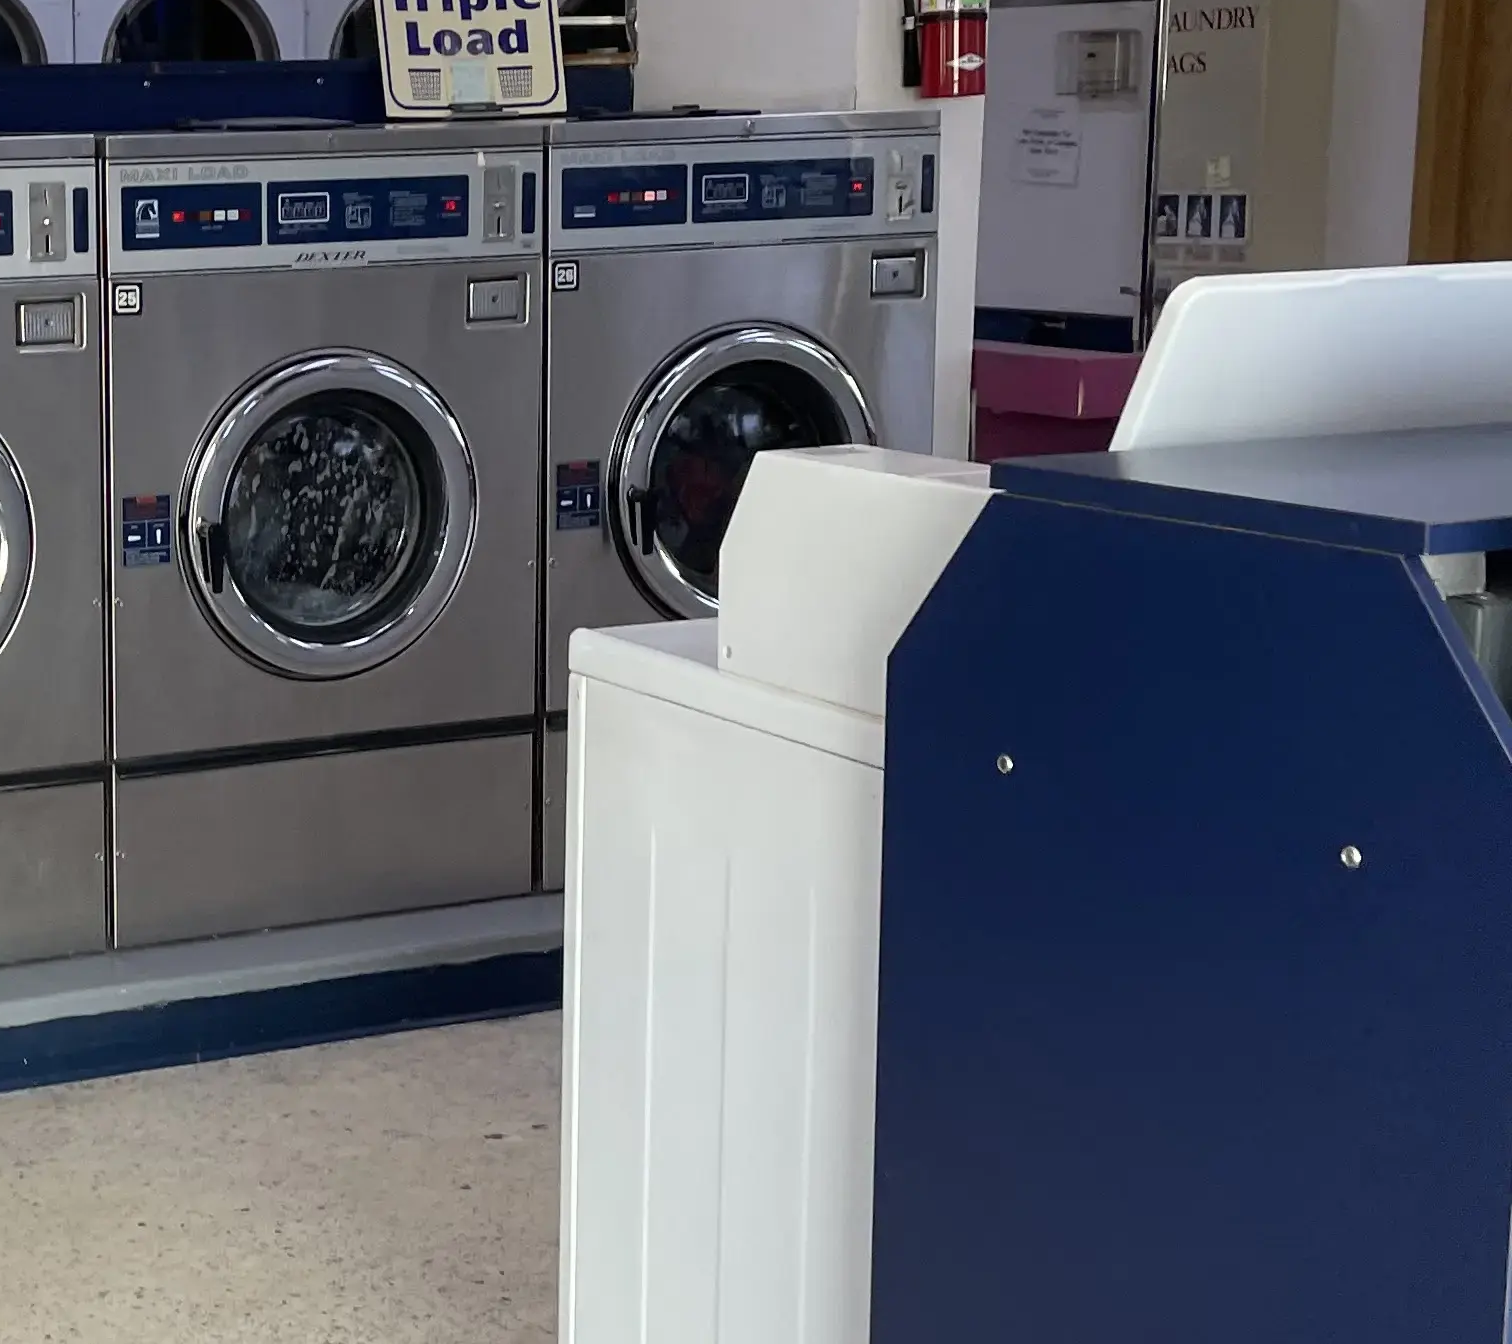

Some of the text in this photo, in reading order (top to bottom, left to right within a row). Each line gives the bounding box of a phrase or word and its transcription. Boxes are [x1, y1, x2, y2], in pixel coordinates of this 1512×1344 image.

[1169, 4, 1260, 33] AUNDRY
[405, 19, 529, 56] Load
[1168, 51, 1207, 74] AGS
[119, 165, 249, 183] MAXI LOAD
[296, 250, 366, 262] DEXTER
[118, 291, 137, 307] 25
